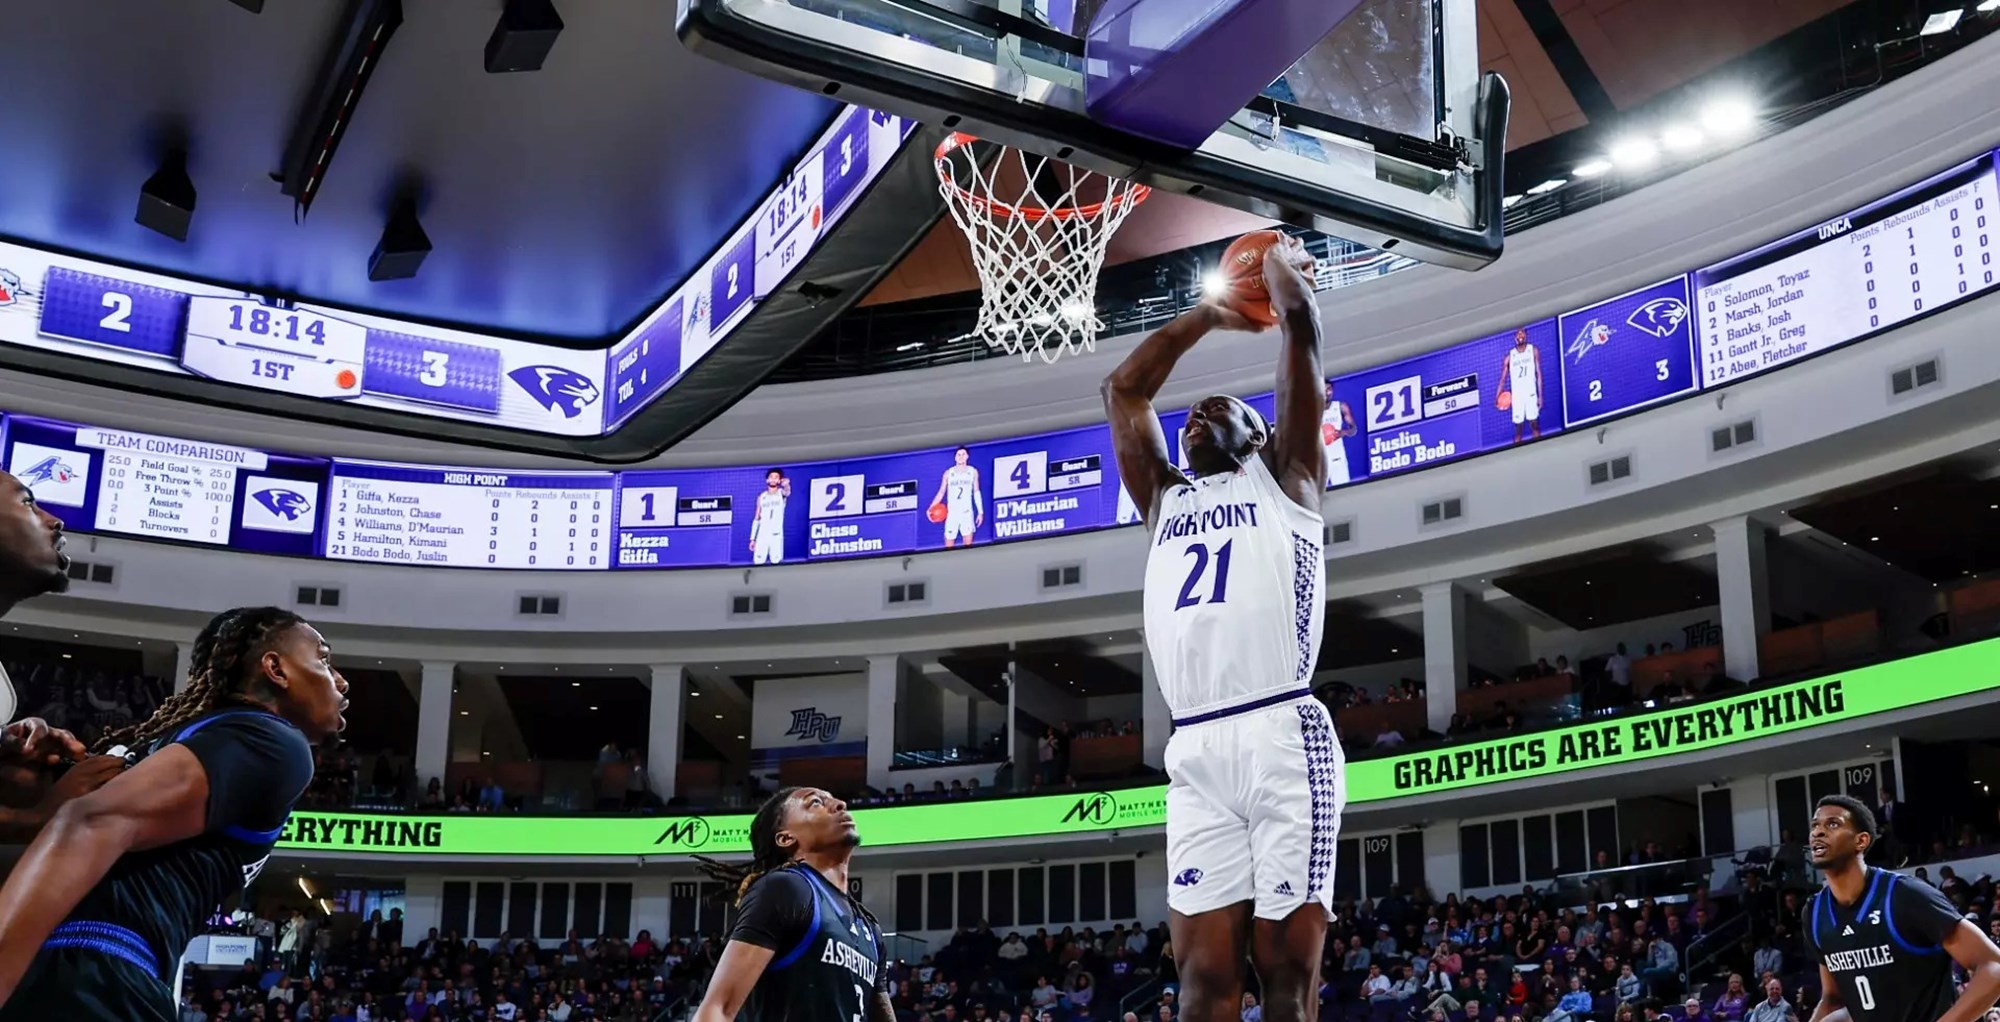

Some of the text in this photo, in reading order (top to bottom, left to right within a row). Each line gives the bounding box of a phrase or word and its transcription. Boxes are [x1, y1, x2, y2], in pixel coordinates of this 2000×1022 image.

[840, 133, 852, 177] 3
[769, 173, 808, 237] 18:14
[1817, 217, 1852, 240] UNCA
[1704, 186, 1969, 298] Player Points Rebounds Assists
[780, 240, 797, 268] 1ST
[1708, 301, 1716, 313] 0
[1777, 268, 1811, 288] Toyaz
[1862, 244, 1871, 257] 2
[1950, 208, 1958, 221] 0
[1975, 197, 1984, 210] 0
[727, 262, 738, 300] 2
[1709, 317, 1717, 329] 2
[1766, 288, 1805, 310] Jordan
[1864, 261, 1873, 274] 0
[1909, 244, 1916, 256] 1
[1952, 225, 1961, 239] 0
[1977, 215, 1986, 228] 0
[1710, 334, 1719, 346] 3
[1767, 310, 1792, 329] Josh
[1866, 279, 1875, 292] 0
[1910, 262, 1918, 275] 0
[1954, 244, 1963, 257] 0
[1979, 234, 1988, 247] 0
[100, 291, 132, 333] 2
[1709, 350, 1724, 364] 11
[1728, 340, 1758, 359] Gantt
[1779, 324, 1806, 342] Greg
[1868, 297, 1877, 310] 0
[1912, 280, 1920, 293] 0
[1958, 263, 1964, 275] 1
[1981, 252, 1990, 265] 0
[229, 304, 325, 345] 18:14
[1709, 367, 1726, 381] 12
[1762, 341, 1808, 365] Fletcher
[1870, 315, 1879, 328] 0
[1914, 298, 1922, 311] 0
[1958, 281, 1967, 294] 0
[1984, 270, 1993, 284] 0
[252, 359, 294, 381] 1ST
[420, 350, 448, 388] 3
[1589, 358, 1669, 401] 2 3
[1430, 376, 1469, 397] Forward
[1373, 384, 1415, 424] 21
[1444, 400, 1457, 410] SO
[97, 431, 246, 463] TEAM COMPARISON
[1370, 440, 1455, 474] Bodo Bodo
[108, 455, 231, 479] 25.0 Field Goal 25.0
[1010, 460, 1030, 490] 4
[1062, 460, 1088, 471] Guard
[109, 467, 227, 490] 0.0 Free Throw 0.0
[341, 479, 592, 501] Player Points Rebounds Assists
[444, 472, 508, 486] HIGH POINT
[879, 482, 904, 496] Guard
[1068, 475, 1081, 485] SR
[108, 479, 232, 504] 0.0 Point 100.0
[150, 497, 183, 508] Assists
[388, 493, 420, 505] Kezza
[492, 499, 500, 508] 0
[531, 500, 539, 510] 2
[570, 501, 577, 510] 0
[593, 501, 600, 510] 0
[825, 482, 845, 512] 2
[110, 503, 219, 525] 2 Blocks 0
[339, 502, 347, 512] 2
[409, 507, 442, 519] Chase
[491, 512, 498, 521] 0
[531, 513, 538, 523] 0
[569, 514, 576, 523] 0
[592, 514, 599, 523] 0
[640, 493, 655, 521] 1
[692, 500, 718, 510] Guard
[885, 501, 898, 510] SR
[997, 497, 1079, 519] D'Maurian
[139, 520, 217, 538] Turnovers 0
[337, 517, 346, 527] 4
[408, 521, 464, 535] D'Maurian
[490, 526, 497, 536] 3
[568, 528, 575, 538] 0
[591, 528, 598, 538] 0
[699, 514, 712, 523] SR
[995, 517, 1065, 538] Williams
[1200, 502, 1257, 533] POINT
[337, 531, 345, 541] 5
[408, 535, 448, 548] Kimani
[489, 540, 496, 550] 0
[529, 541, 536, 551] 0
[590, 542, 597, 551] 0
[620, 533, 669, 549] Kezza
[810, 522, 858, 538] Chase
[331, 545, 346, 555] 21
[351, 546, 379, 558] Bodo
[488, 554, 495, 564] 0
[529, 555, 536, 565] 0
[567, 556, 574, 565] 0
[589, 556, 596, 565] 0
[619, 548, 658, 565] Giffa
[810, 537, 883, 556] Johnston
[1174, 537, 1233, 612] 21
[784, 707, 842, 743] HPU
[1394, 680, 1845, 790] GRAPHICS ARE EVERYTHING
[1845, 766, 1871, 785] 109
[1365, 836, 1389, 853] 109
[673, 884, 695, 898] 111
[1824, 944, 1894, 973] ASHEVILLE
[1855, 975, 1876, 1011] 0
